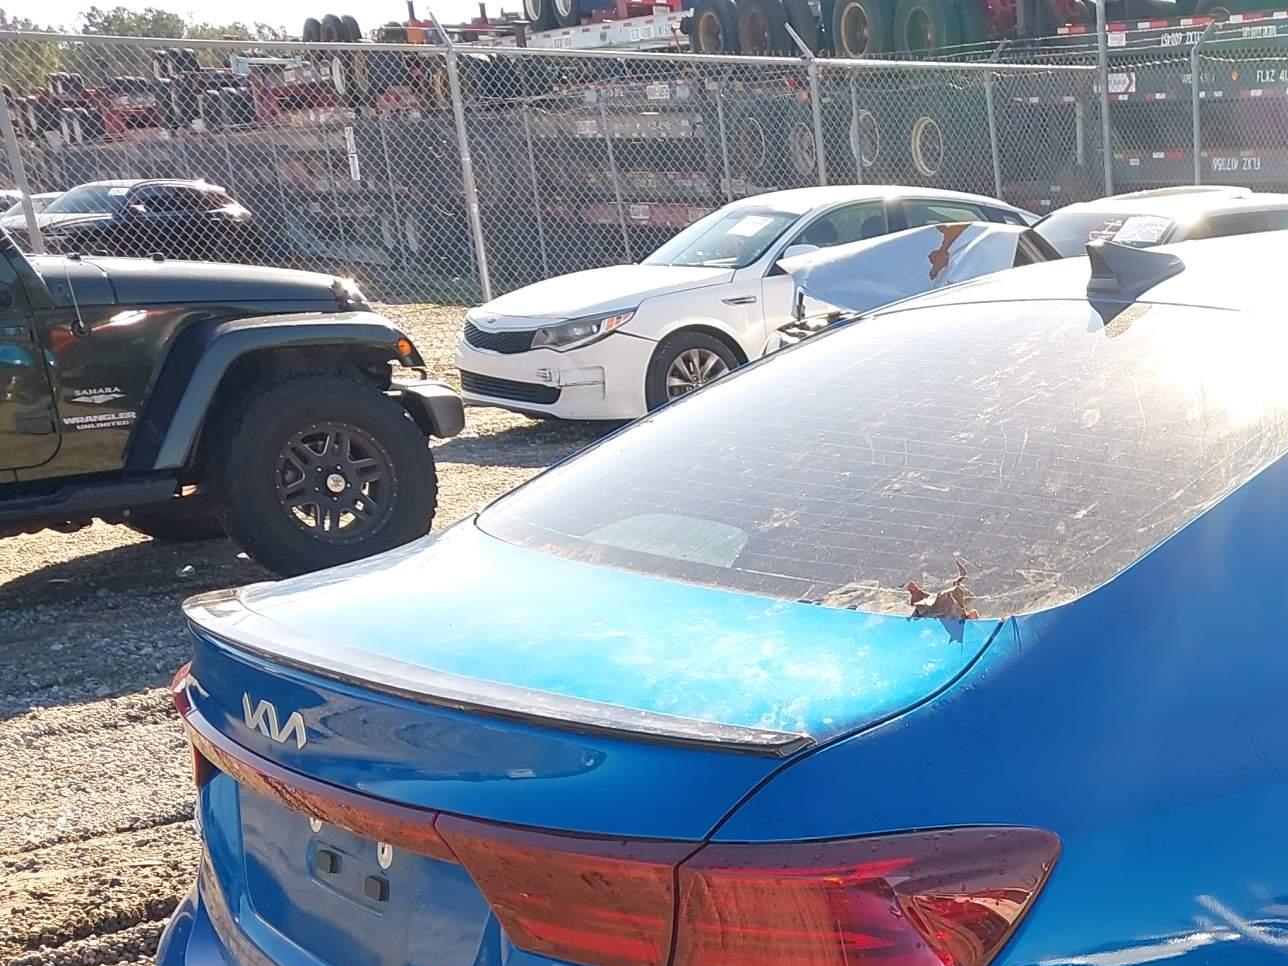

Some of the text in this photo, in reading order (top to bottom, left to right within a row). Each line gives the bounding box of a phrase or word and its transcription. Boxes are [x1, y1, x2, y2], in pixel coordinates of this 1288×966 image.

[1256, 68, 1276, 82] FLXZ
[74, 386, 121, 396] SAHARA
[62, 411, 137, 425] WRANGLER
[76, 420, 130, 430] UNLIMITED
[242, 691, 307, 751] KIA
